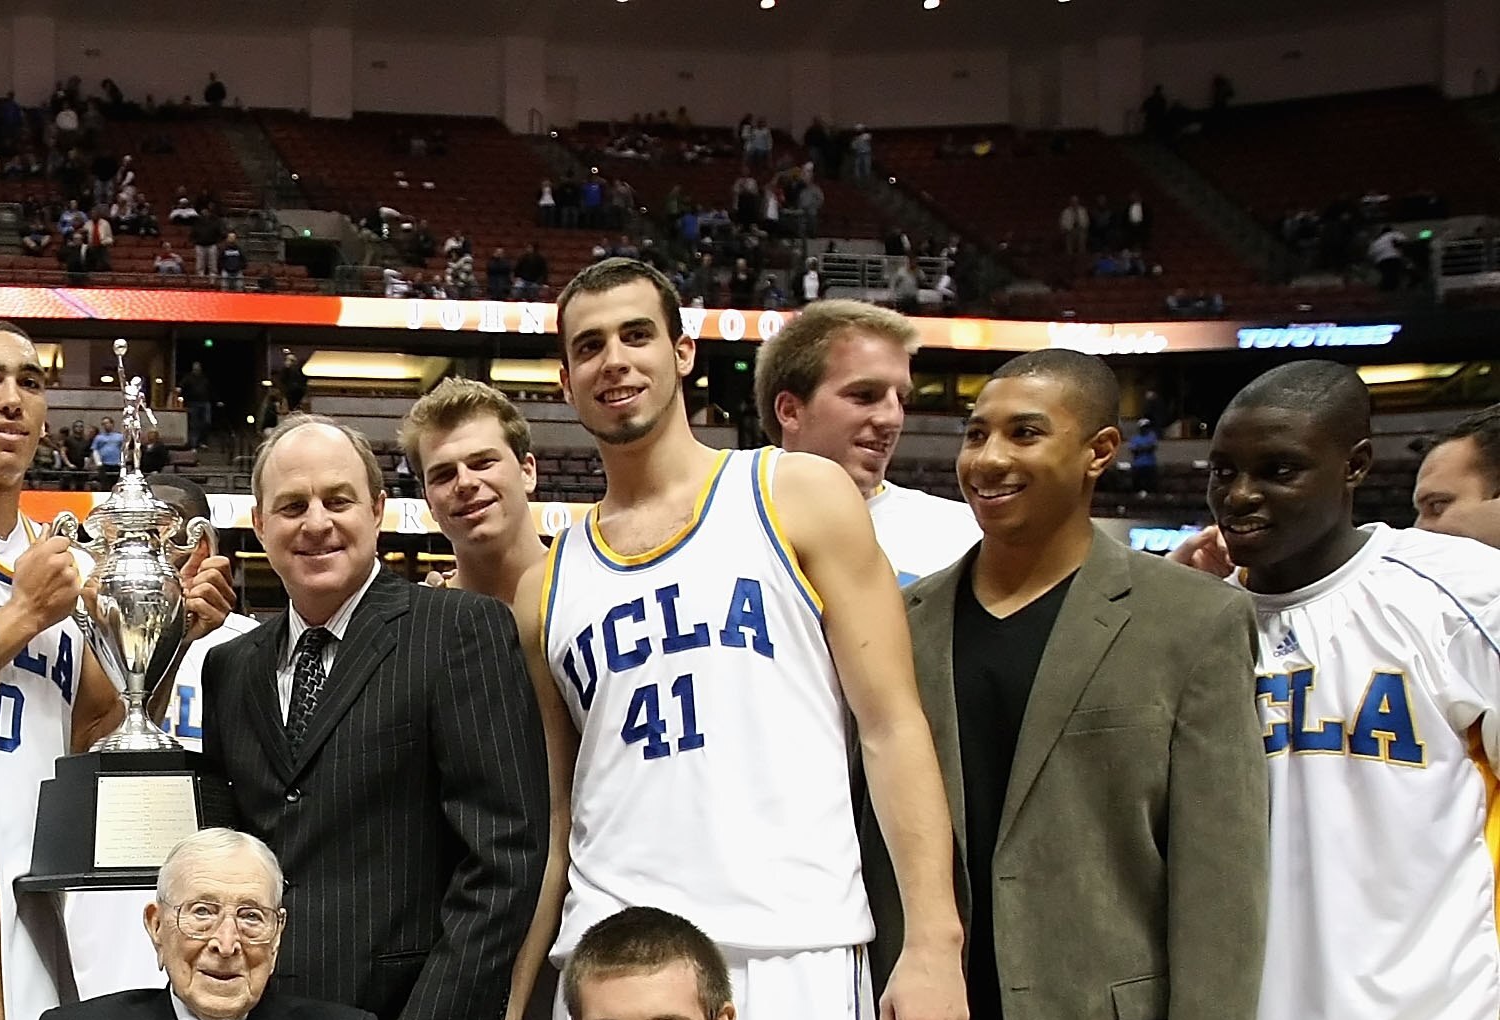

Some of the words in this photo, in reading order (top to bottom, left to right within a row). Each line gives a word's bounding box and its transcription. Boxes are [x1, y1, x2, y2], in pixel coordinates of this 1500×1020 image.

[404, 298, 546, 334] JOHN
[679, 307, 785, 341] WOO
[563, 577, 774, 711] UCLA
[621, 673, 704, 760] 41
[1255, 665, 1427, 769] CLA
